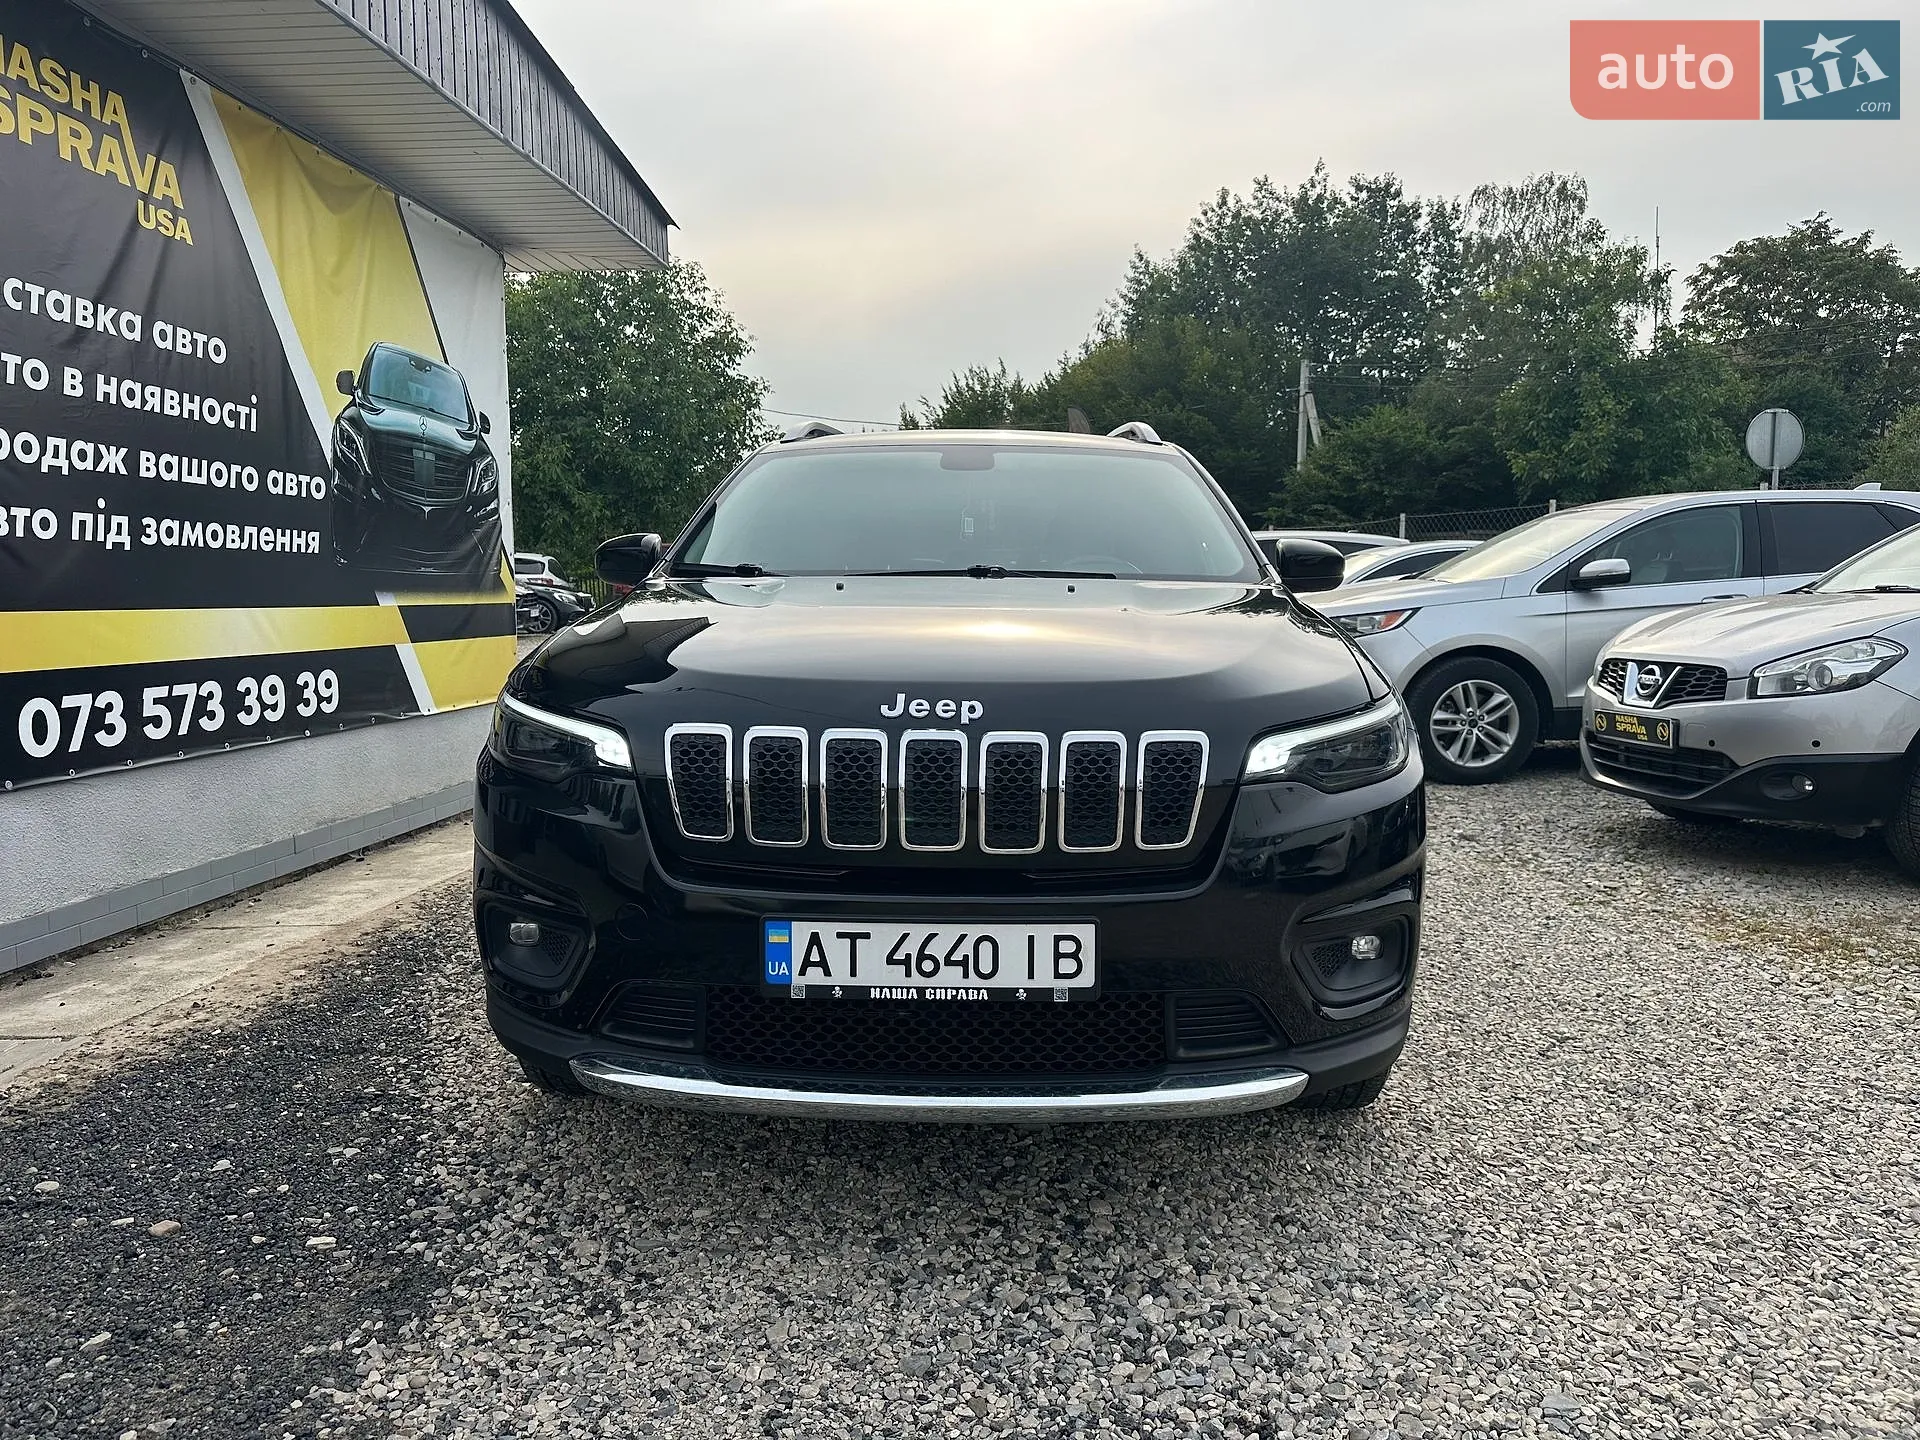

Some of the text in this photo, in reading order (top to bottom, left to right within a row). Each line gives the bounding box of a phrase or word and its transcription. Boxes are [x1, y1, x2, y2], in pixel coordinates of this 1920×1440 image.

[0, 34, 124, 127] ASHA
[137, 199, 194, 246] USA
[3, 277, 228, 365] ставка авто
[63, 366, 84, 398] в
[96, 373, 258, 432] наявності
[139, 450, 259, 492] вашого
[266, 469, 327, 500] авто
[71, 498, 131, 551] під
[140, 517, 320, 554] замовлення
[18, 669, 340, 758] 073 573 39 39
[880, 693, 984, 725] Jeep
[1615, 714, 1637, 724] NASHA
[1615, 722, 1647, 735] SPRAVA
[768, 961, 789, 976] UA
[885, 932, 1000, 981] 4640
[870, 987, 989, 1001] НАША СПРАВА
